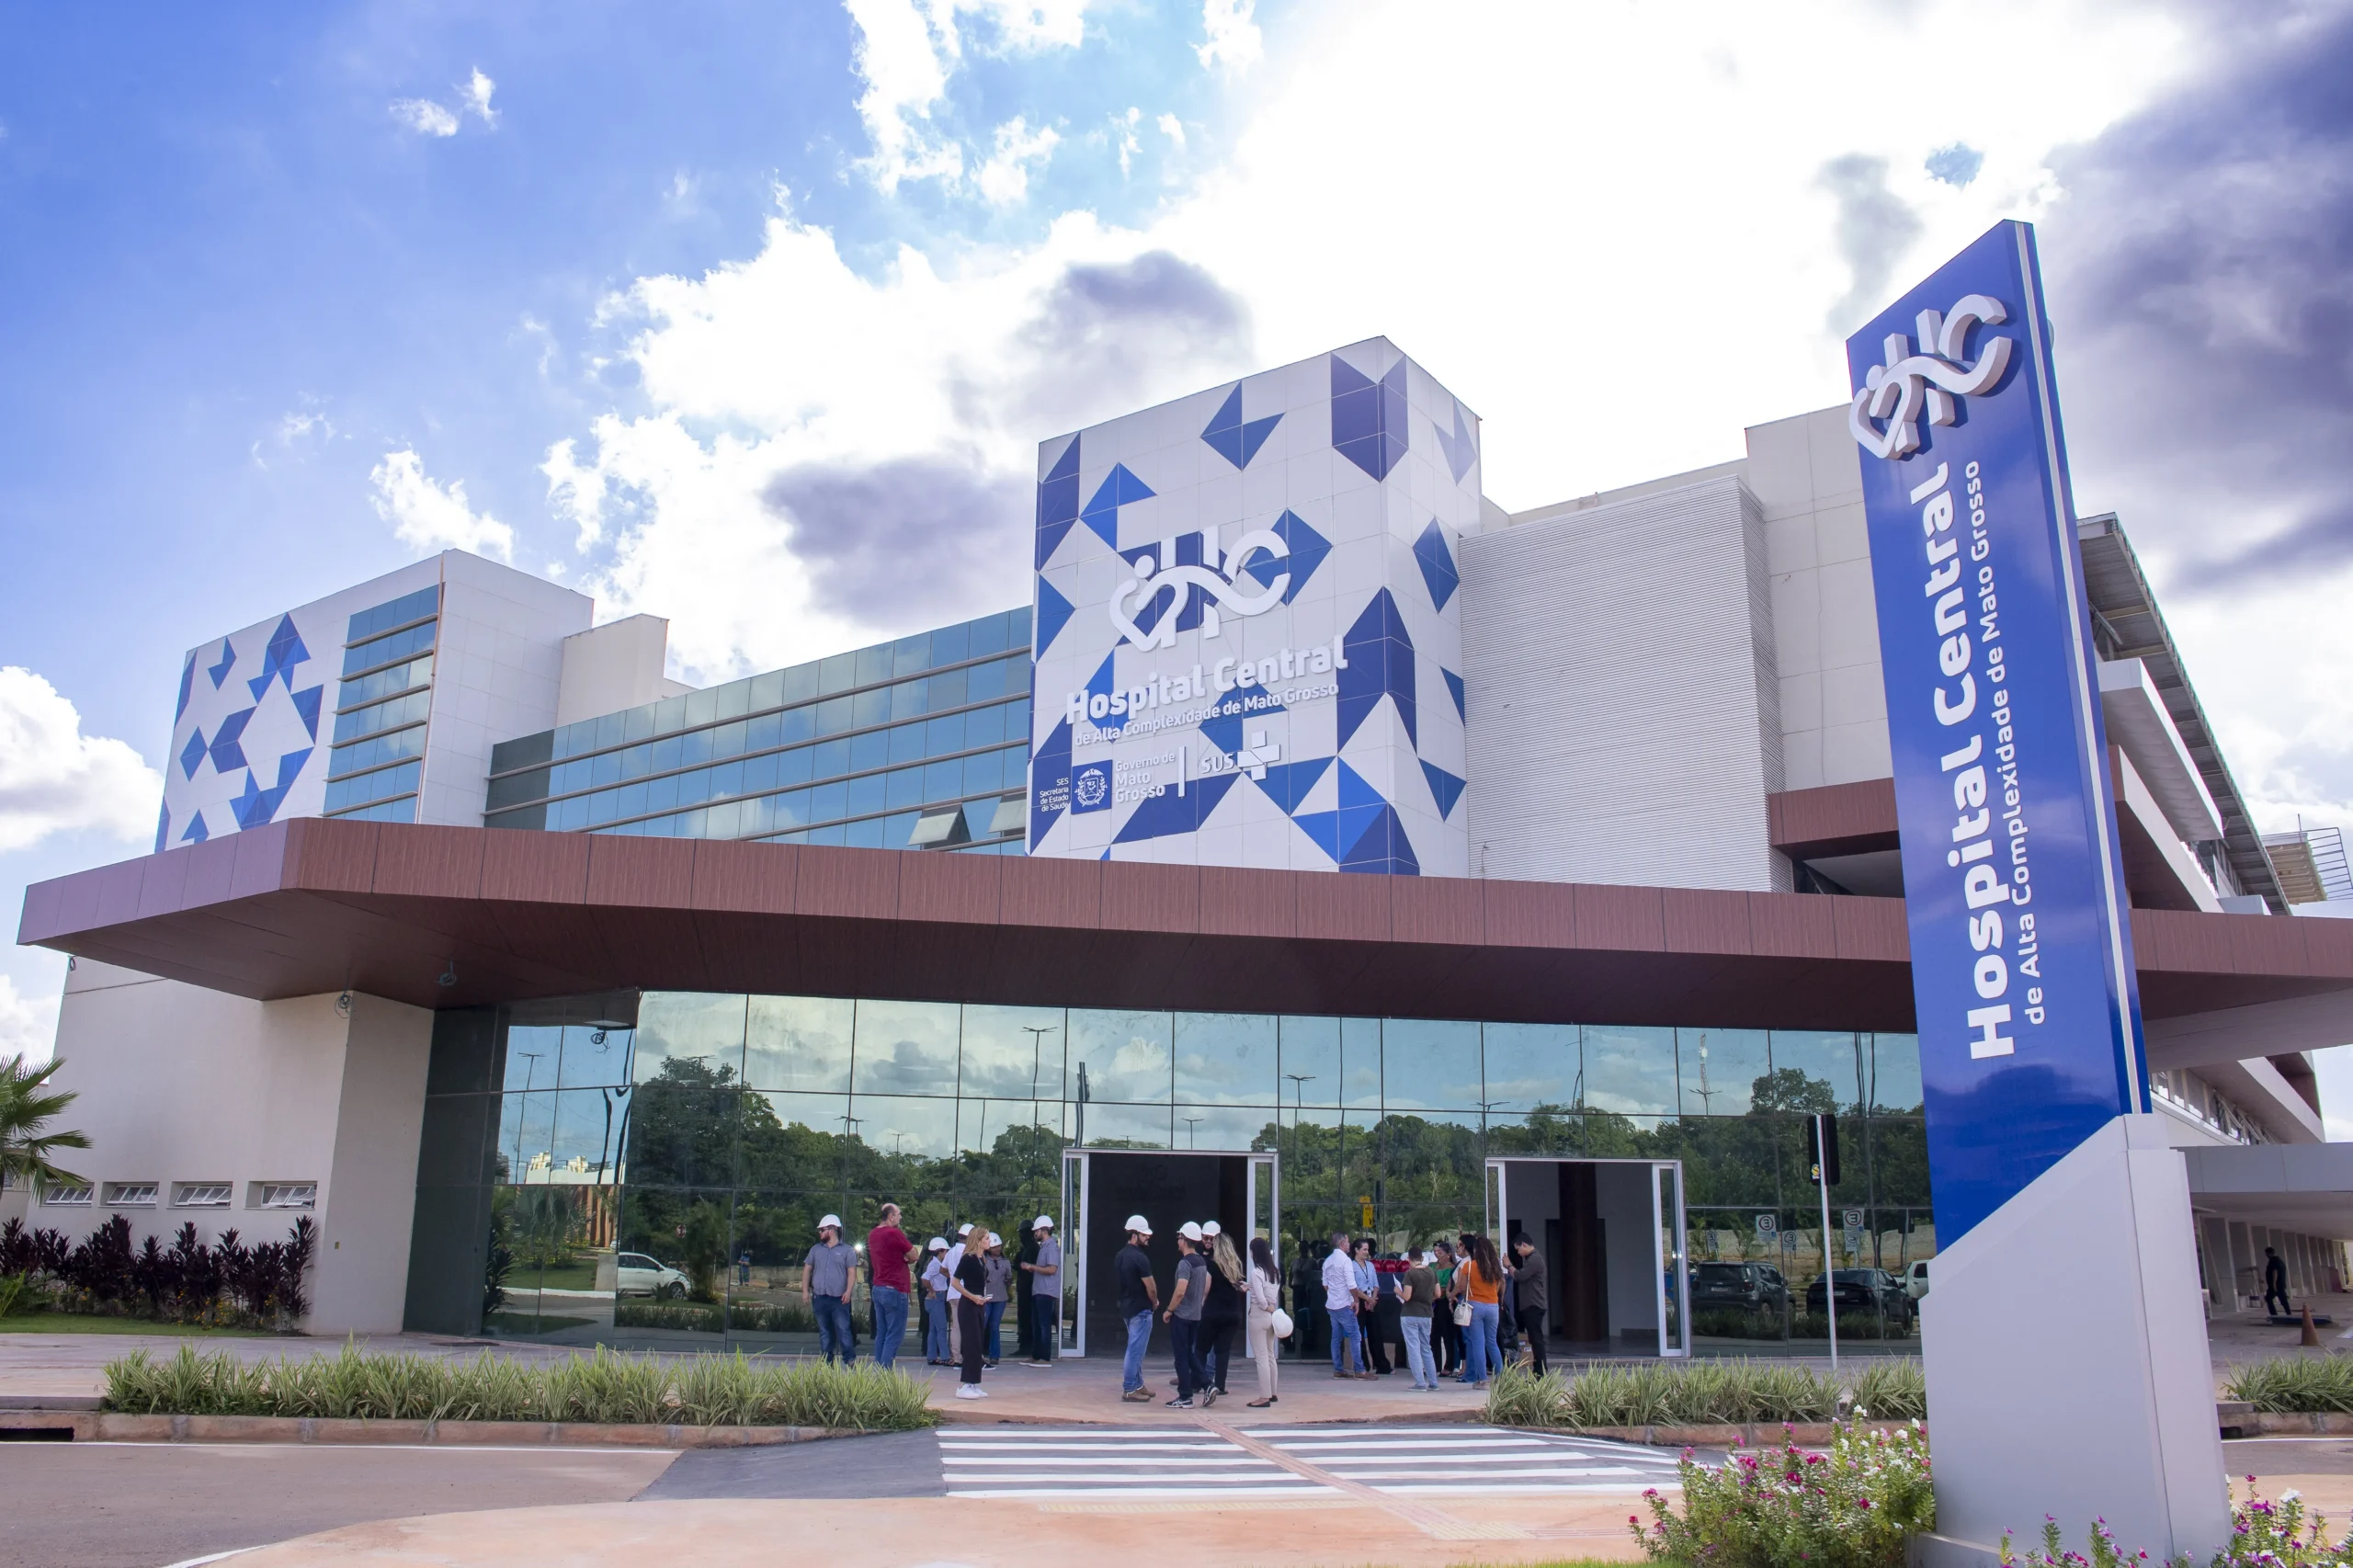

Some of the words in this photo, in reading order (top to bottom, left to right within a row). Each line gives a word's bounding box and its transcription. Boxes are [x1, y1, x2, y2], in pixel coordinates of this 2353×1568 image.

[1965, 460, 1990, 562] Grosso
[1910, 461, 1977, 726] Central
[1978, 566, 2001, 642] Mato
[1065, 665, 1206, 725] Hospital
[1213, 634, 1348, 692] Central
[1986, 645, 2006, 684] de
[1074, 729, 1092, 746] de
[1093, 724, 1120, 744] Alta
[1123, 705, 1221, 737] Complexidade
[1222, 700, 1242, 716] de
[1244, 694, 1282, 712] Mato
[1286, 683, 1339, 704] Grosso
[1115, 755, 1160, 772] Governo
[1162, 751, 1176, 764] de
[1115, 771, 1152, 788] Mato
[1200, 752, 1235, 774] SUS
[1040, 786, 1069, 798] Secretaria
[1040, 797, 1048, 805] de
[1049, 794, 1069, 804] Estado
[1057, 778, 1069, 786] SES
[1115, 785, 1165, 803] Grosso
[1991, 688, 2032, 905] Complexidade
[1940, 733, 2015, 1060] Hospital
[2018, 913, 2041, 978] Alta
[2024, 986, 2046, 1026] de
